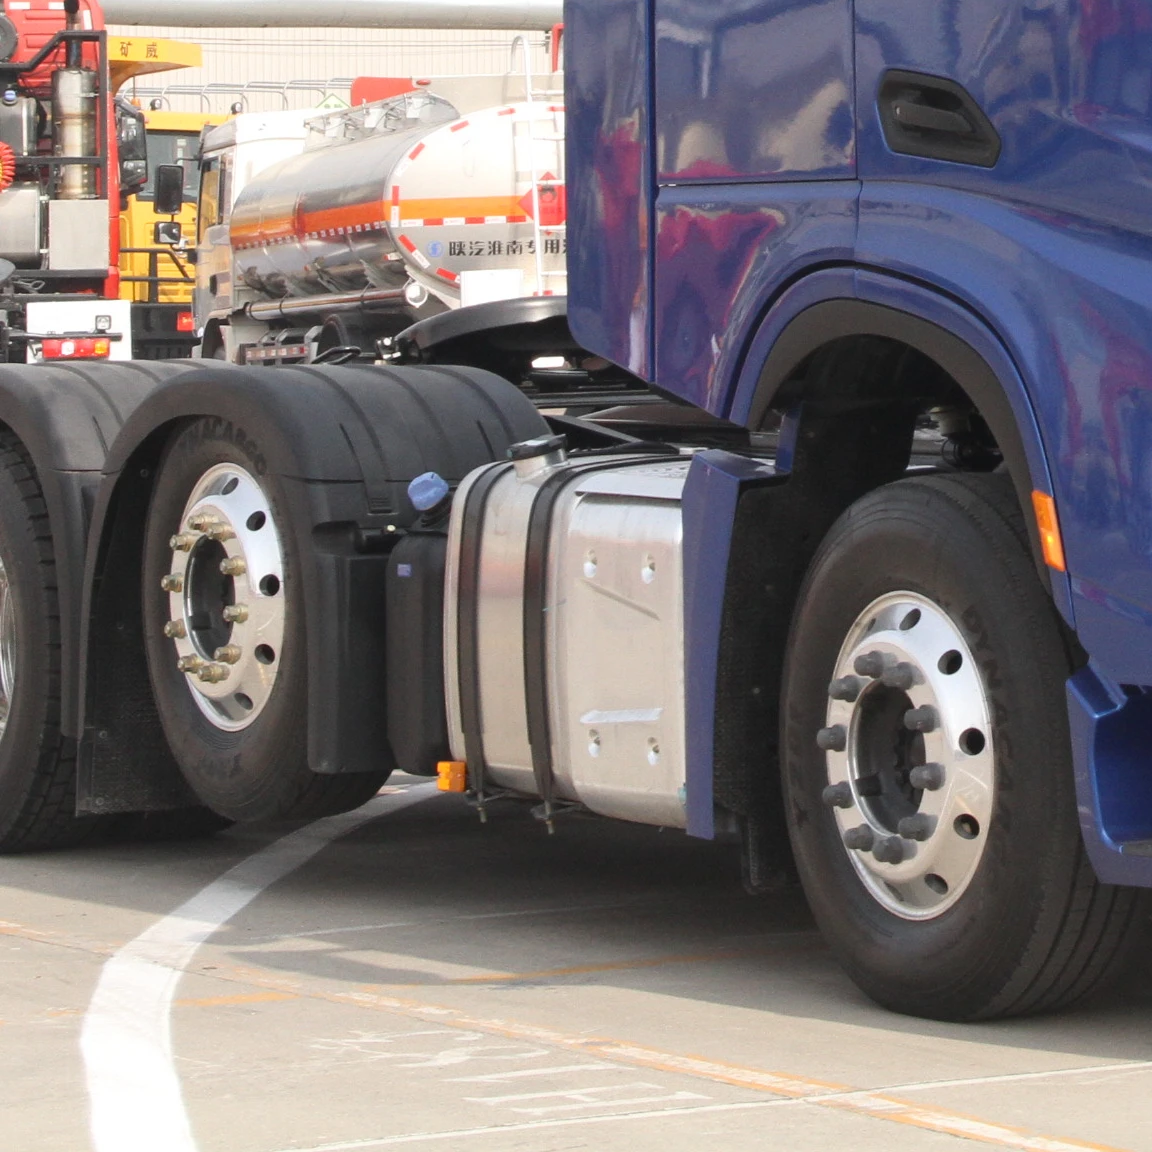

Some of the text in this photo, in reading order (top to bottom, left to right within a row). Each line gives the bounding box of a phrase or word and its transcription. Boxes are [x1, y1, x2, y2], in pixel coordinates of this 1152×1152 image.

[449, 239, 567, 257] 陕汽淮南专用
